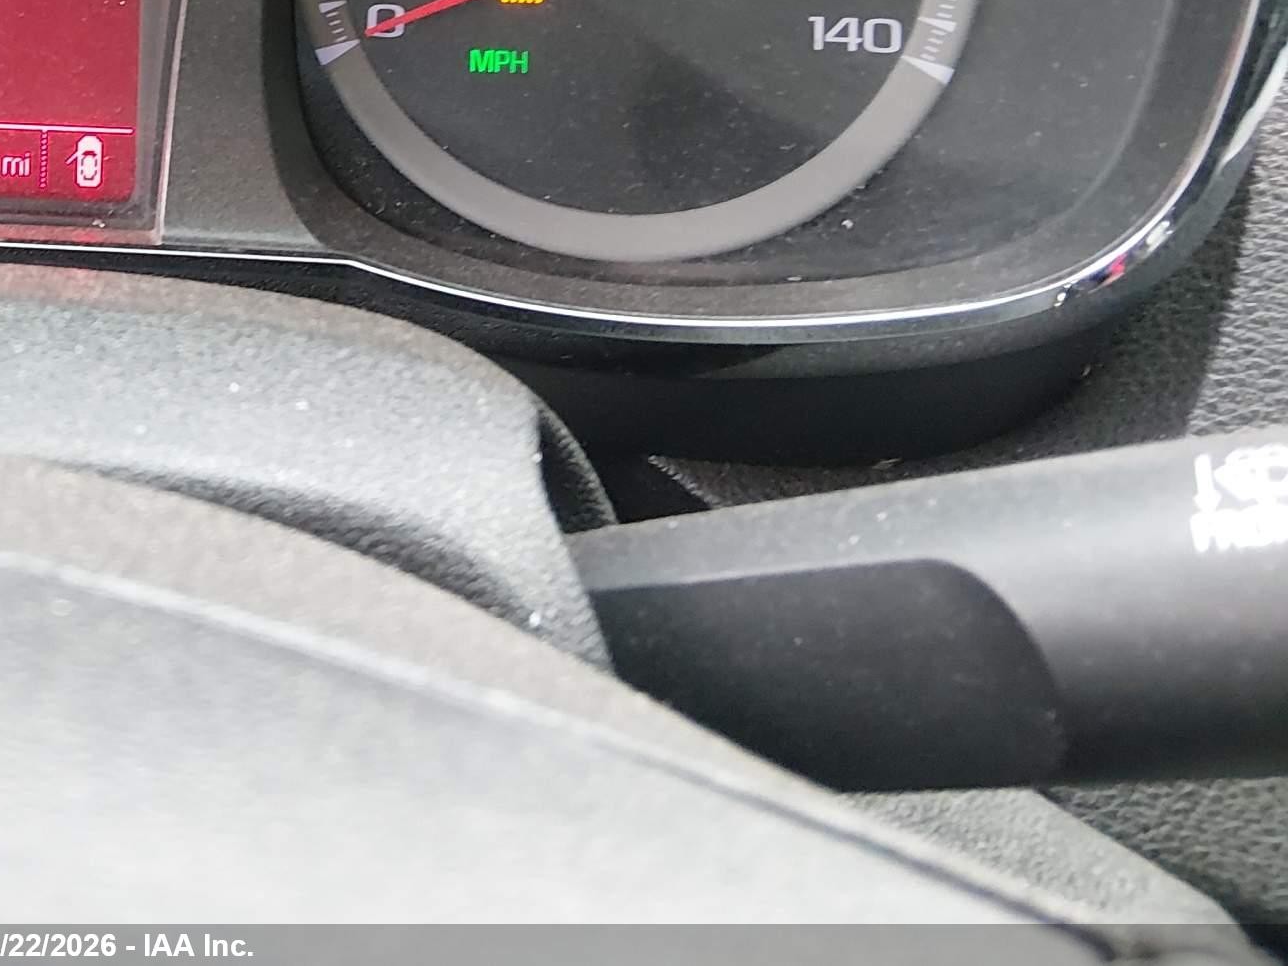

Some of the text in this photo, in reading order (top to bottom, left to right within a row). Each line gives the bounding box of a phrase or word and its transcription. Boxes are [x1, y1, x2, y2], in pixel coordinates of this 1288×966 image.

[808, 16, 903, 53] 140
[468, 48, 529, 74] MPH
[0, 152, 31, 176] mi
